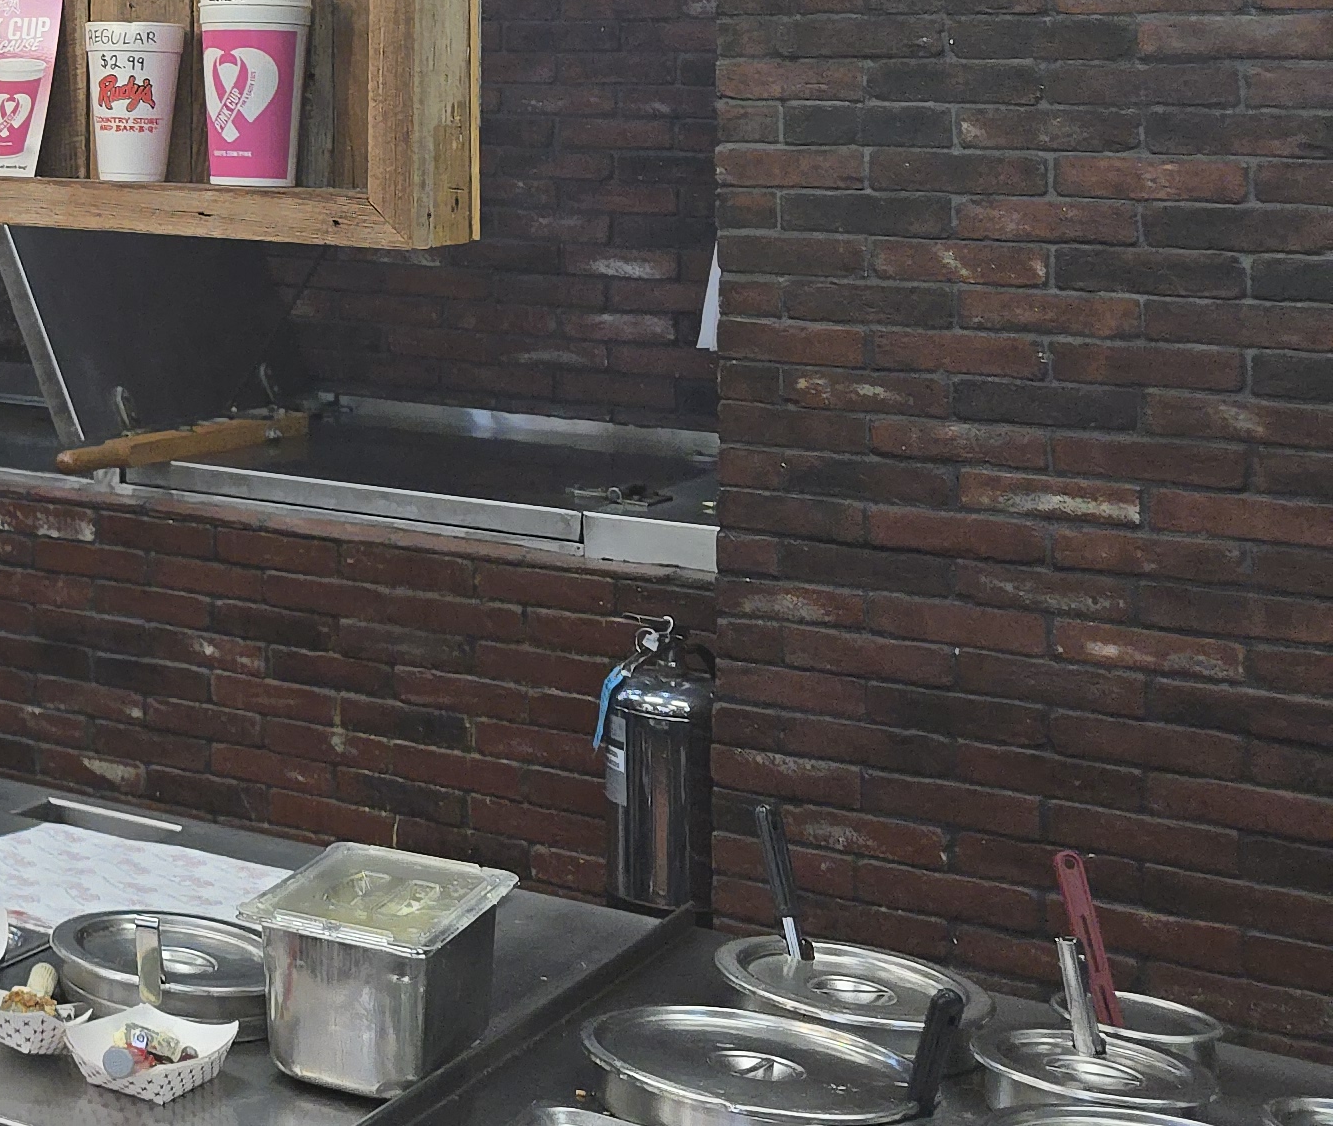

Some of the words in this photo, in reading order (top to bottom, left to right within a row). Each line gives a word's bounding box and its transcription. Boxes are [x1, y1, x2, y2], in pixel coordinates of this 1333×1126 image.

[8, 17, 50, 40] CUP
[88, 29, 157, 45] REGULAR
[101, 54, 144, 71] $2.99
[98, 74, 155, 112] Rudy's
[214, 105, 232, 133] PINK
[225, 87, 241, 110] CUP
